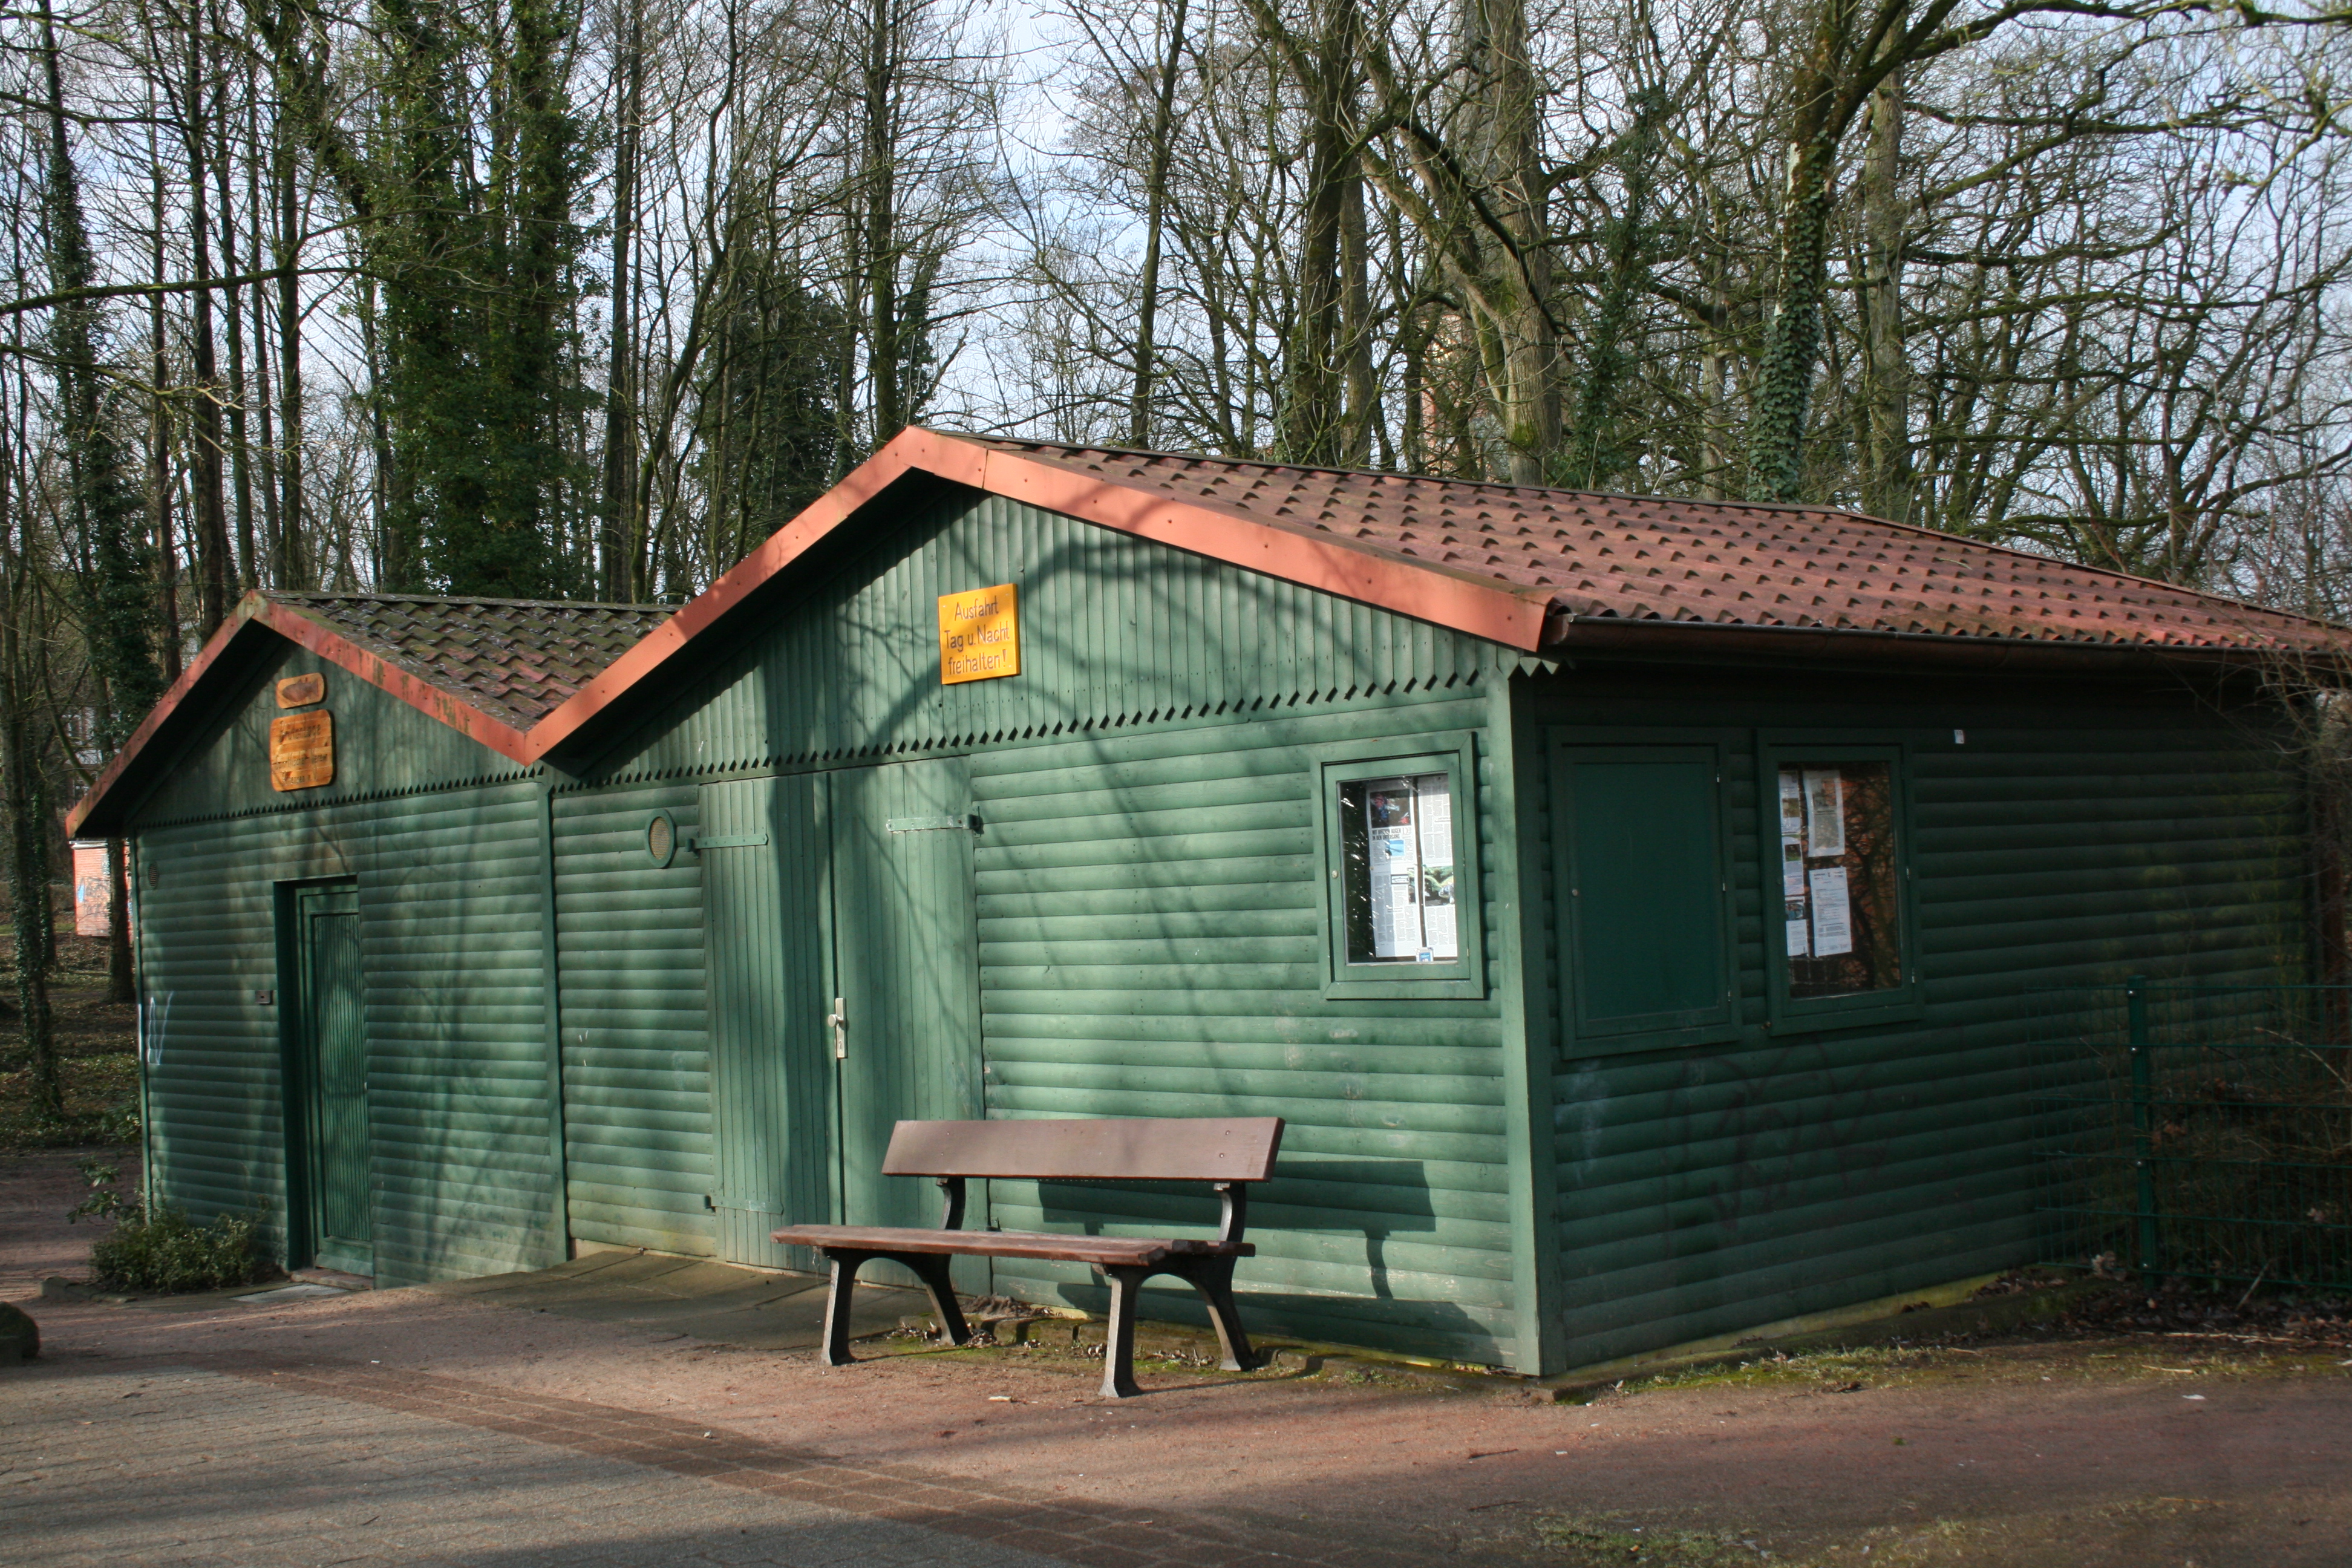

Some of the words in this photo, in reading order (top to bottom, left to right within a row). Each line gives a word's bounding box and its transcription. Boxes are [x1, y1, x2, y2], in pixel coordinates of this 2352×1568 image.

[954, 595, 999, 621] Ausfahrt
[944, 630, 964, 653] Tag
[967, 633, 976, 645] u.
[977, 620, 1010, 645] Nacht
